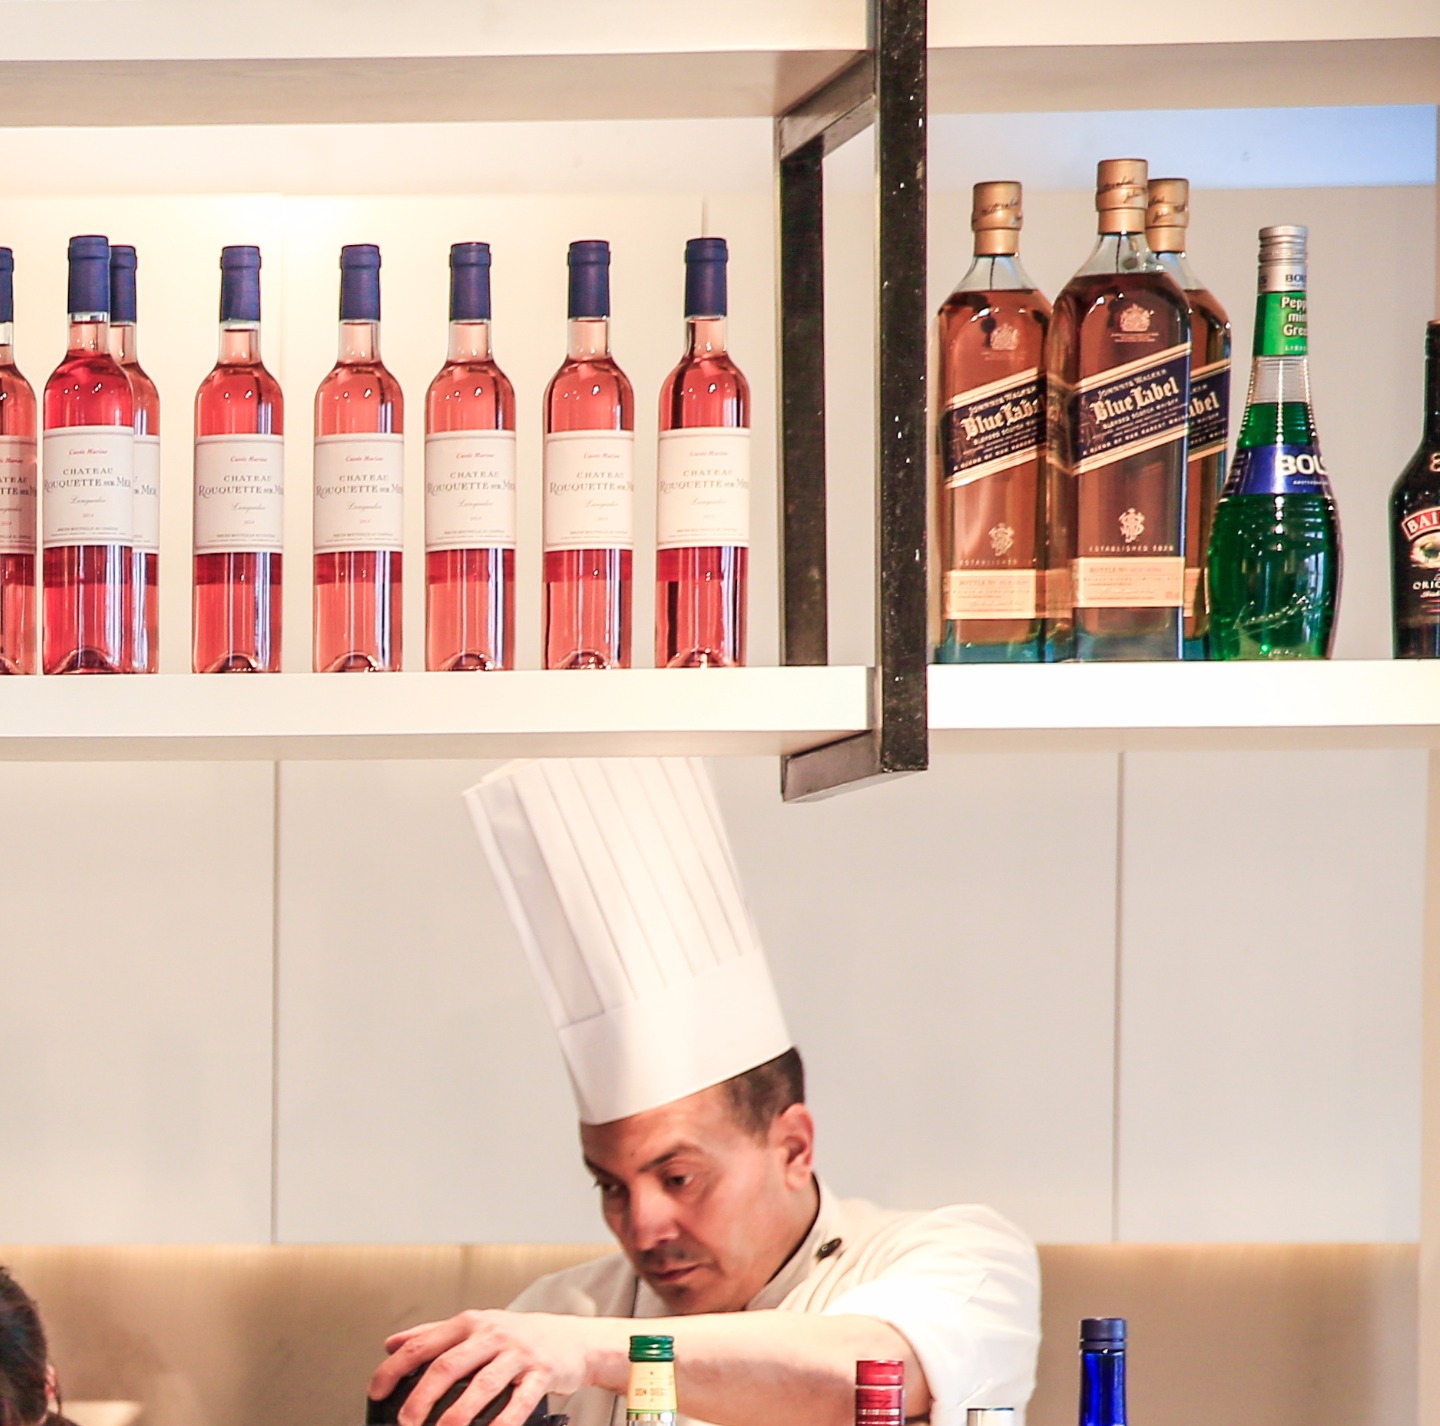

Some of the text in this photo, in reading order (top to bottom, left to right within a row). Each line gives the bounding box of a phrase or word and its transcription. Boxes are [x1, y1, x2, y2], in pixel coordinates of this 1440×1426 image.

[1089, 376, 1180, 425] Blue Label
[960, 413, 1005, 441] Blue
[63, 467, 113, 475] CHATEAU
